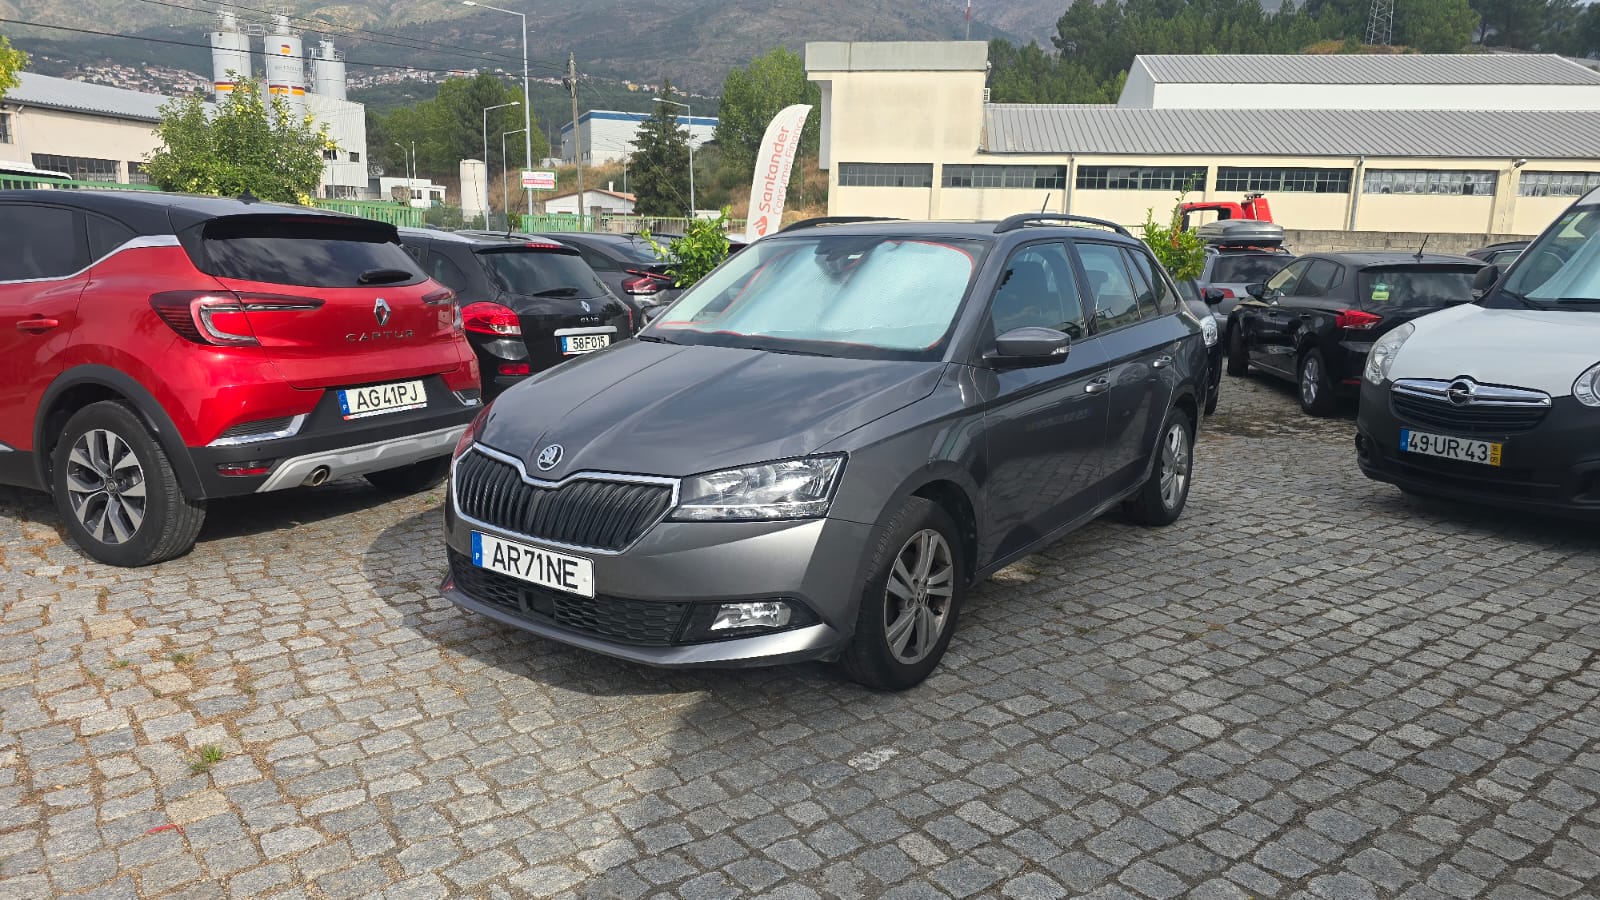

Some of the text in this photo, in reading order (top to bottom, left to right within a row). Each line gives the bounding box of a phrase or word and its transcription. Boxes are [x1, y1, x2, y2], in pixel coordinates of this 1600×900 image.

[759, 127, 789, 212] Santander
[773, 116, 804, 215] Consumer Finance
[345, 329, 414, 342] CAPTUR
[357, 383, 418, 409] AG41PJ
[492, 541, 579, 589] AR71NE
